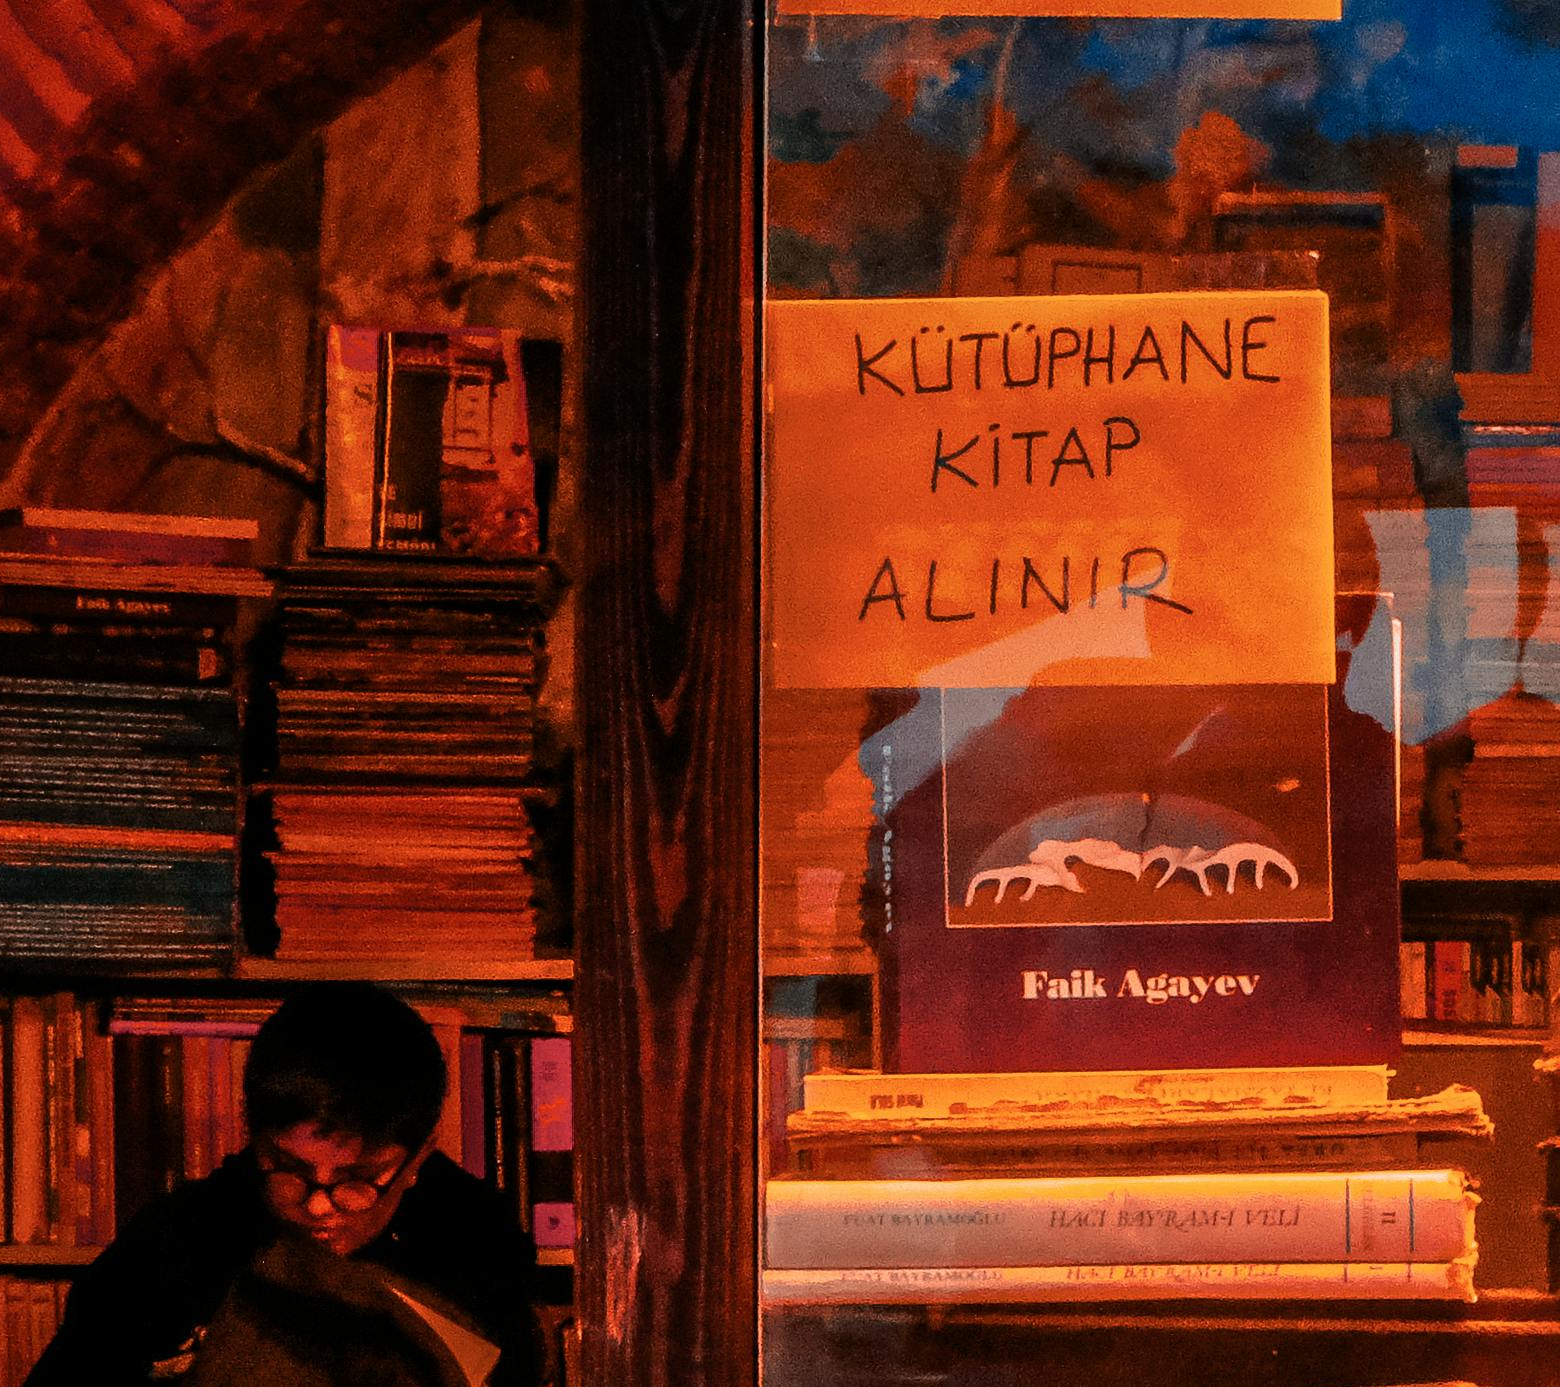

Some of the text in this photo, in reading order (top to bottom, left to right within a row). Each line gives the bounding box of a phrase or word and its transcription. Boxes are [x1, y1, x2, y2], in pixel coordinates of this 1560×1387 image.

[855, 316, 1280, 396] KÜTÜPHANE
[931, 417, 1141, 492] KİTAP
[859, 547, 1193, 623] ALINIR
[1022, 969, 1260, 1005] Faik Agayev
[1048, 1206, 1106, 1230] HACI
